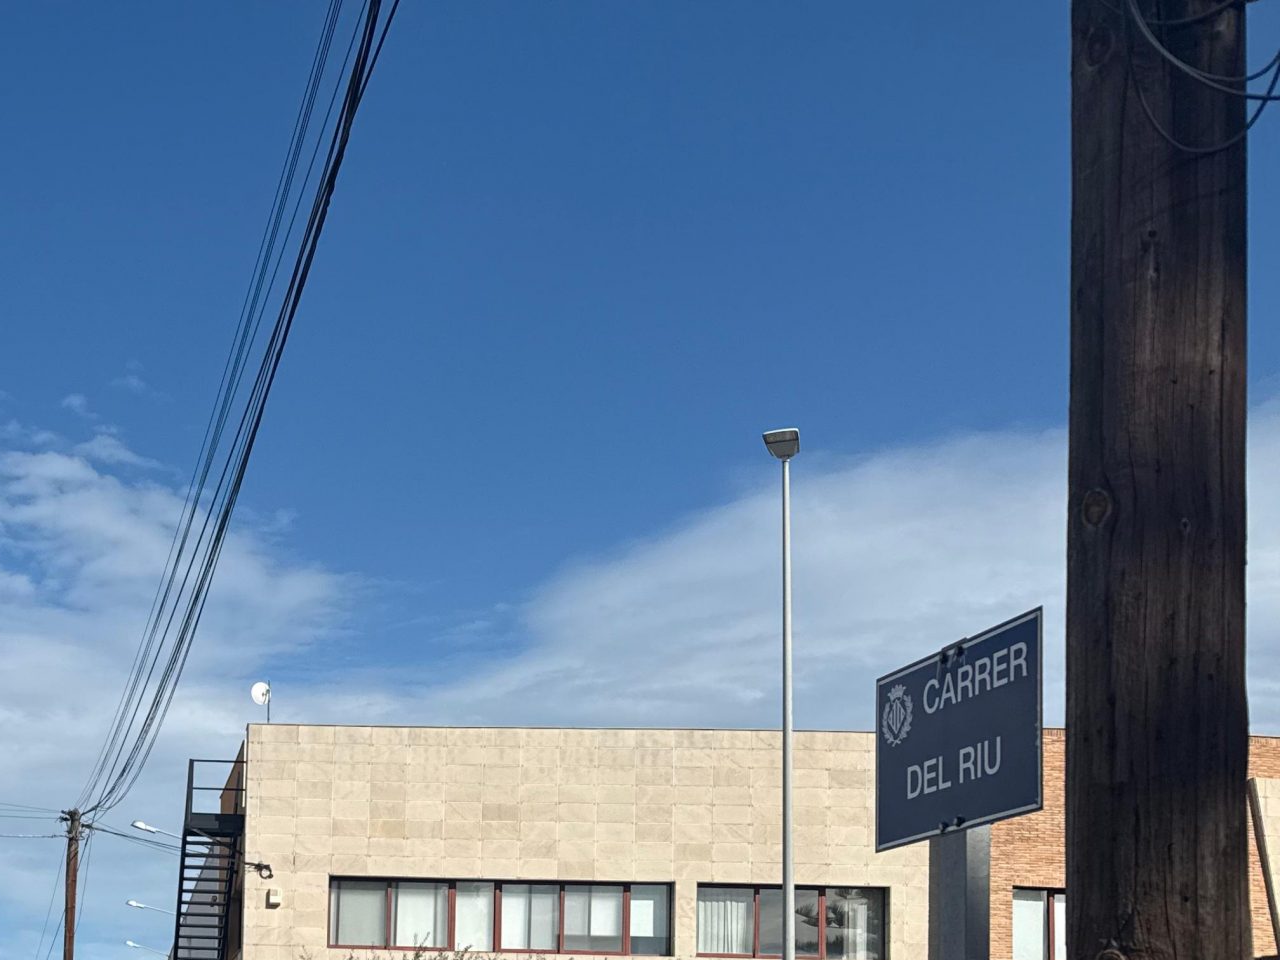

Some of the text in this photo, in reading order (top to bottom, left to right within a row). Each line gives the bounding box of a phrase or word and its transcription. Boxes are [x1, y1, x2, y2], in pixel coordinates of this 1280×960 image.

[922, 641, 1028, 715] CARRER
[906, 735, 1002, 800] DEL RIU
